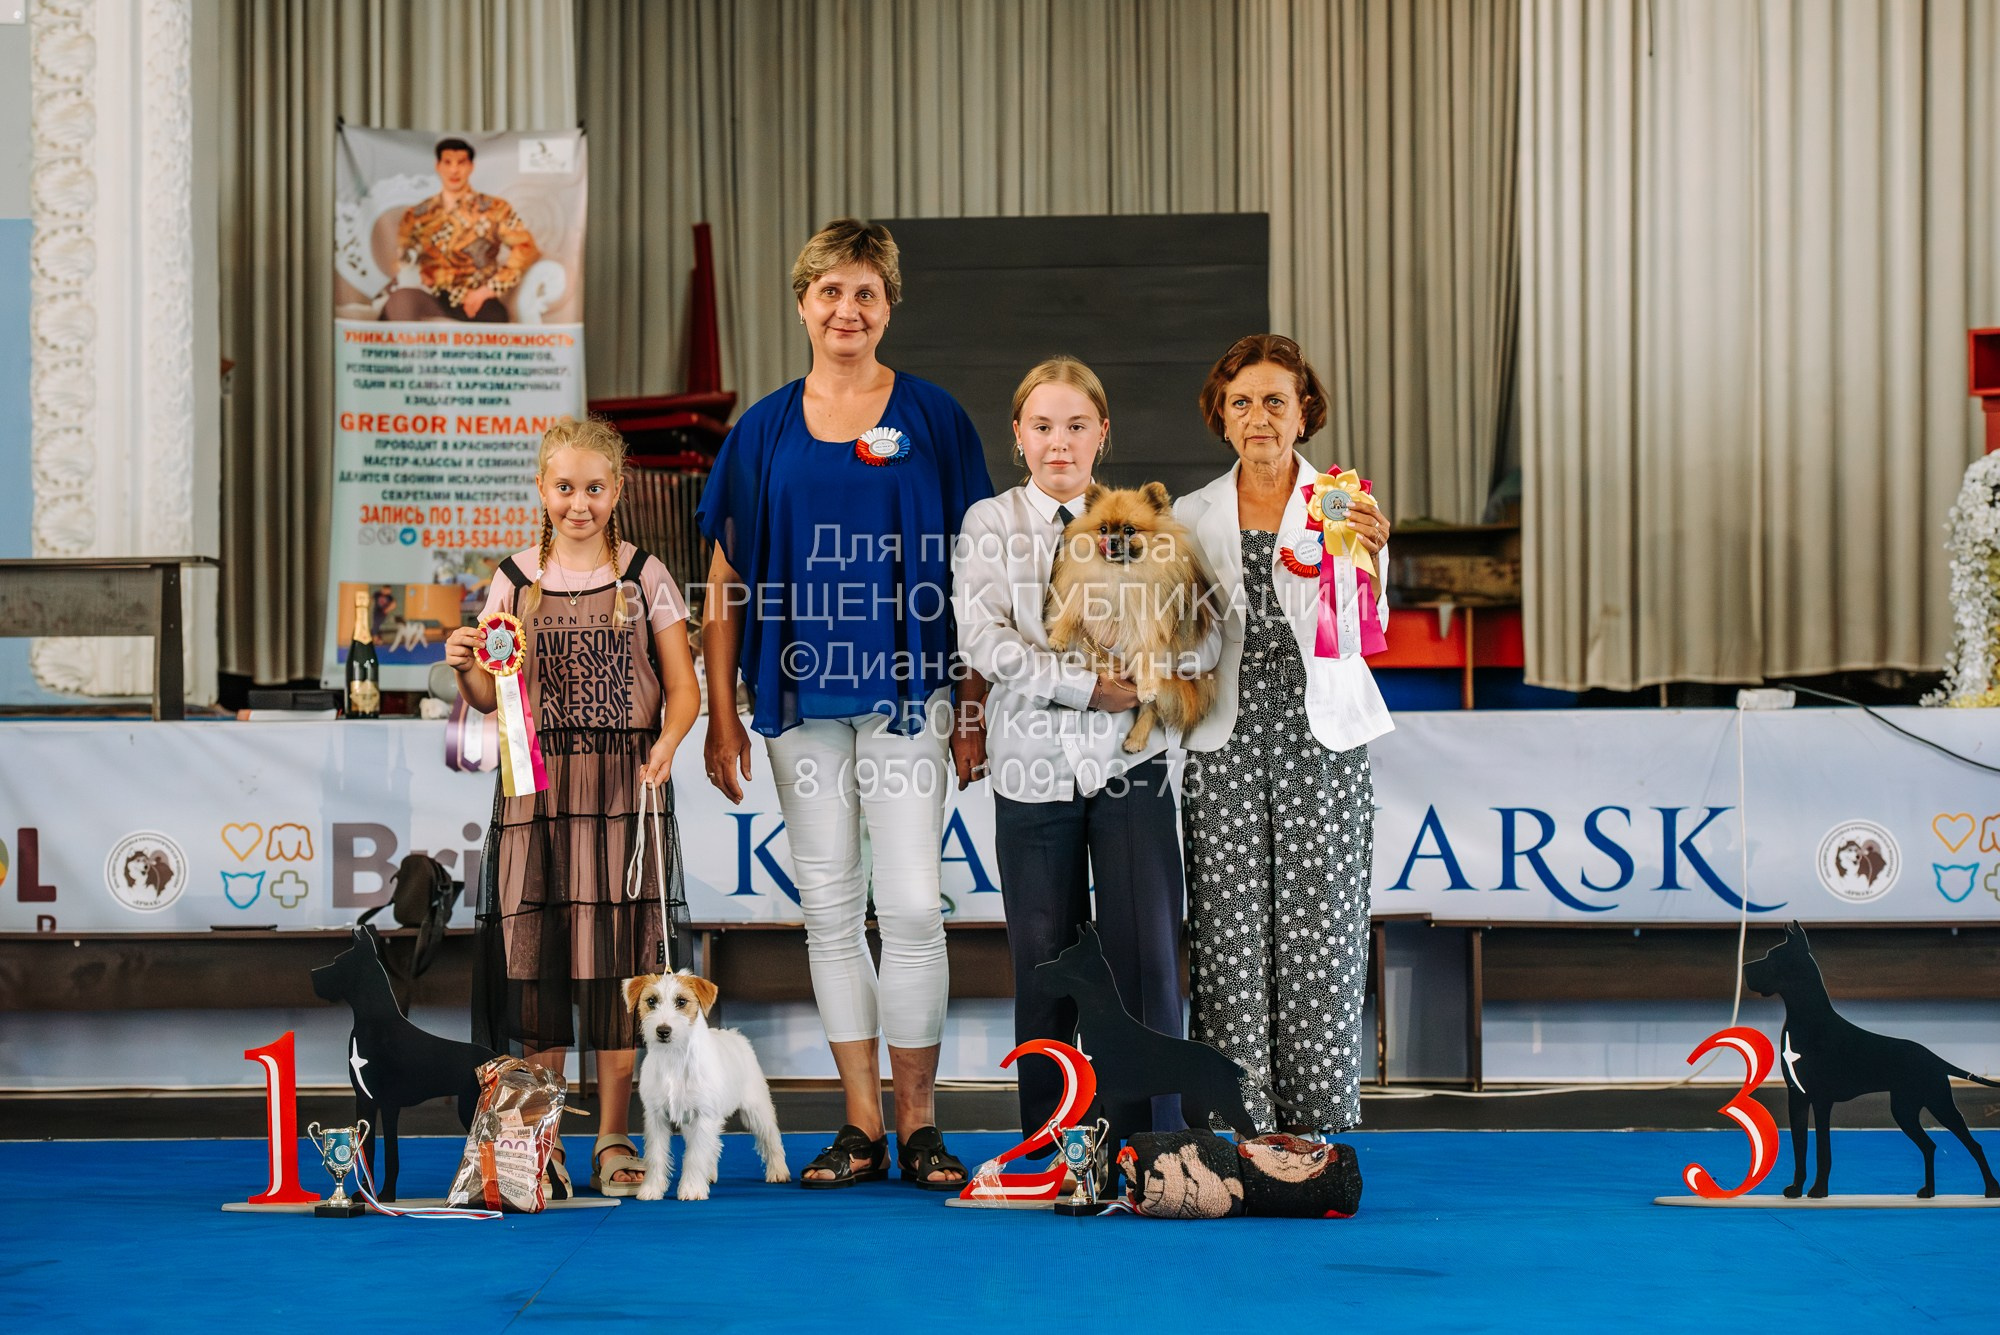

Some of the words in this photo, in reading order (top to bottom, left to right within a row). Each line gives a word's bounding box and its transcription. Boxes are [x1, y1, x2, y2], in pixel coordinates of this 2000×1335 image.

[344, 331, 448, 346] УНИКАЛЬНАЯ
[453, 332, 575, 347] ВОЗМОЖНОСТЬ
[353, 379, 386, 390] ОДИН
[478, 397, 511, 407] МИРА
[340, 412, 447, 434] GREGOR
[374, 439, 438, 451] ПРОВОДИТ
[442, 441, 449, 450] В
[363, 455, 463, 467] МАСТЕР-КЛАССЫ
[466, 458, 474, 467] И
[338, 471, 391, 484] ДЕЛИТСЯ
[393, 473, 445, 484] СВОИМИ
[381, 489, 451, 501] СЕКРЕТАМИ
[454, 491, 529, 502] МАСТЕРСТВА
[359, 504, 425, 525] ЗАПИСЬ
[429, 506, 451, 525] ПО
[456, 507, 469, 525] Т.
[533, 615, 577, 627] BORN
[589, 614, 609, 625] TO
[535, 629, 635, 659] AWESOME
[244, 1030, 321, 1205] 1
[958, 1037, 1097, 1201] 2
[1682, 1026, 1779, 1198] 3
